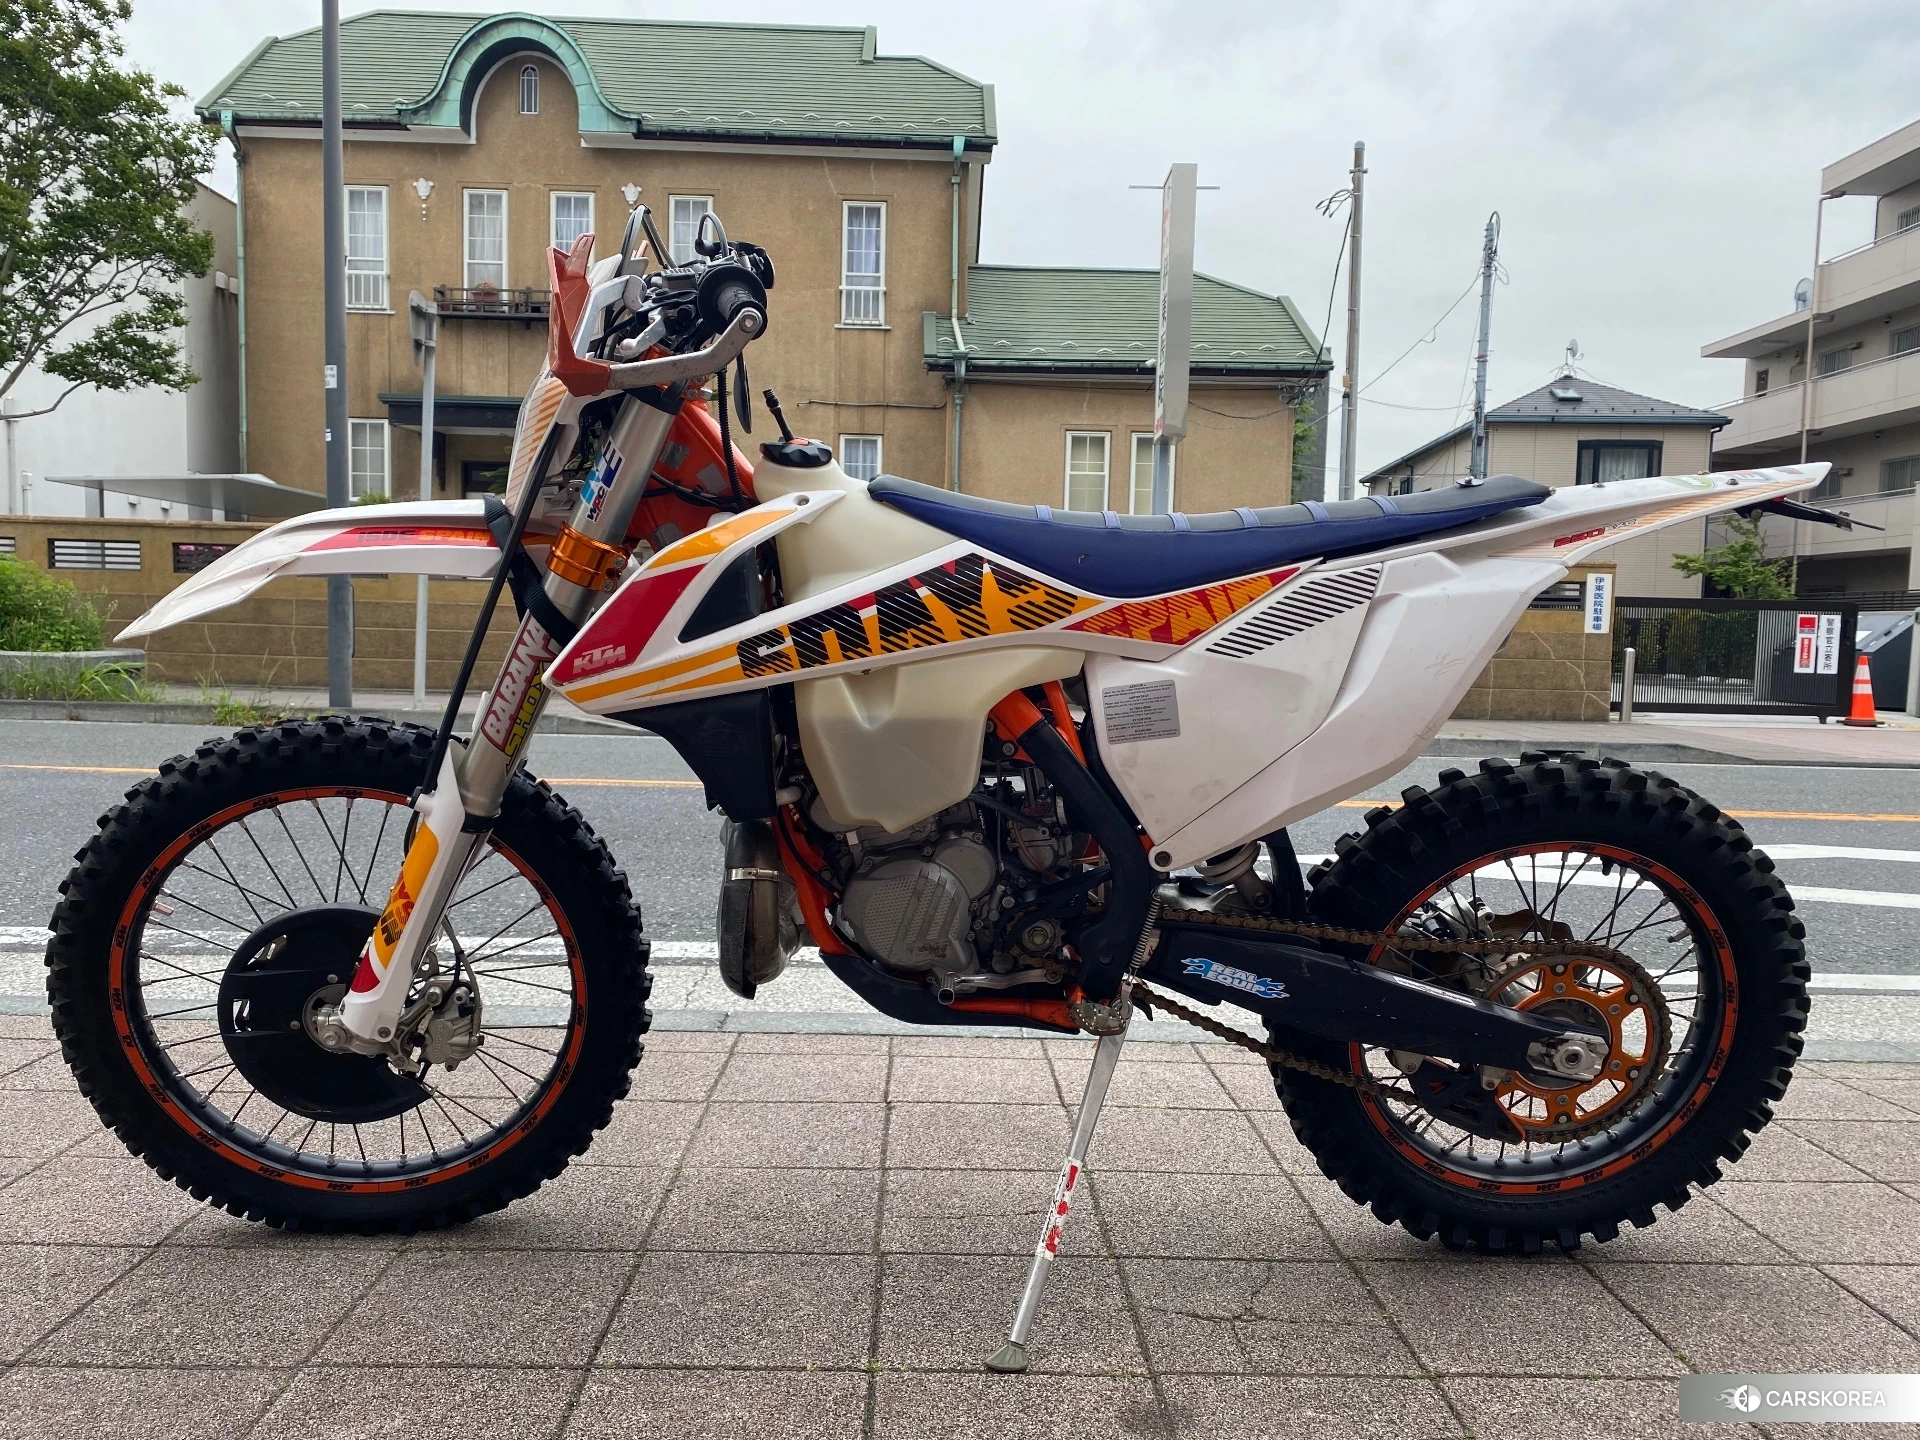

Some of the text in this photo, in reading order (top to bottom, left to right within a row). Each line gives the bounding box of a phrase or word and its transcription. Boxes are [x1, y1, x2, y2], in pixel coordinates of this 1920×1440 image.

[418, 529, 492, 542] SPAIN
[1592, 576, 1605, 631] 伊東医院駐車場
[1822, 617, 1836, 671] 警察官立寄所
[572, 644, 627, 675] KTM
[483, 613, 556, 746] BABANA
[187, 821, 212, 841] KTM
[141, 865, 160, 889] KTM
[115, 924, 128, 949] KTM
[1710, 928, 1727, 950] KTM
[1207, 970, 1267, 993] EQUIP
[1210, 961, 1258, 984] REAL
[557, 1061, 572, 1086] KTM
[520, 1113, 539, 1134] KTM
